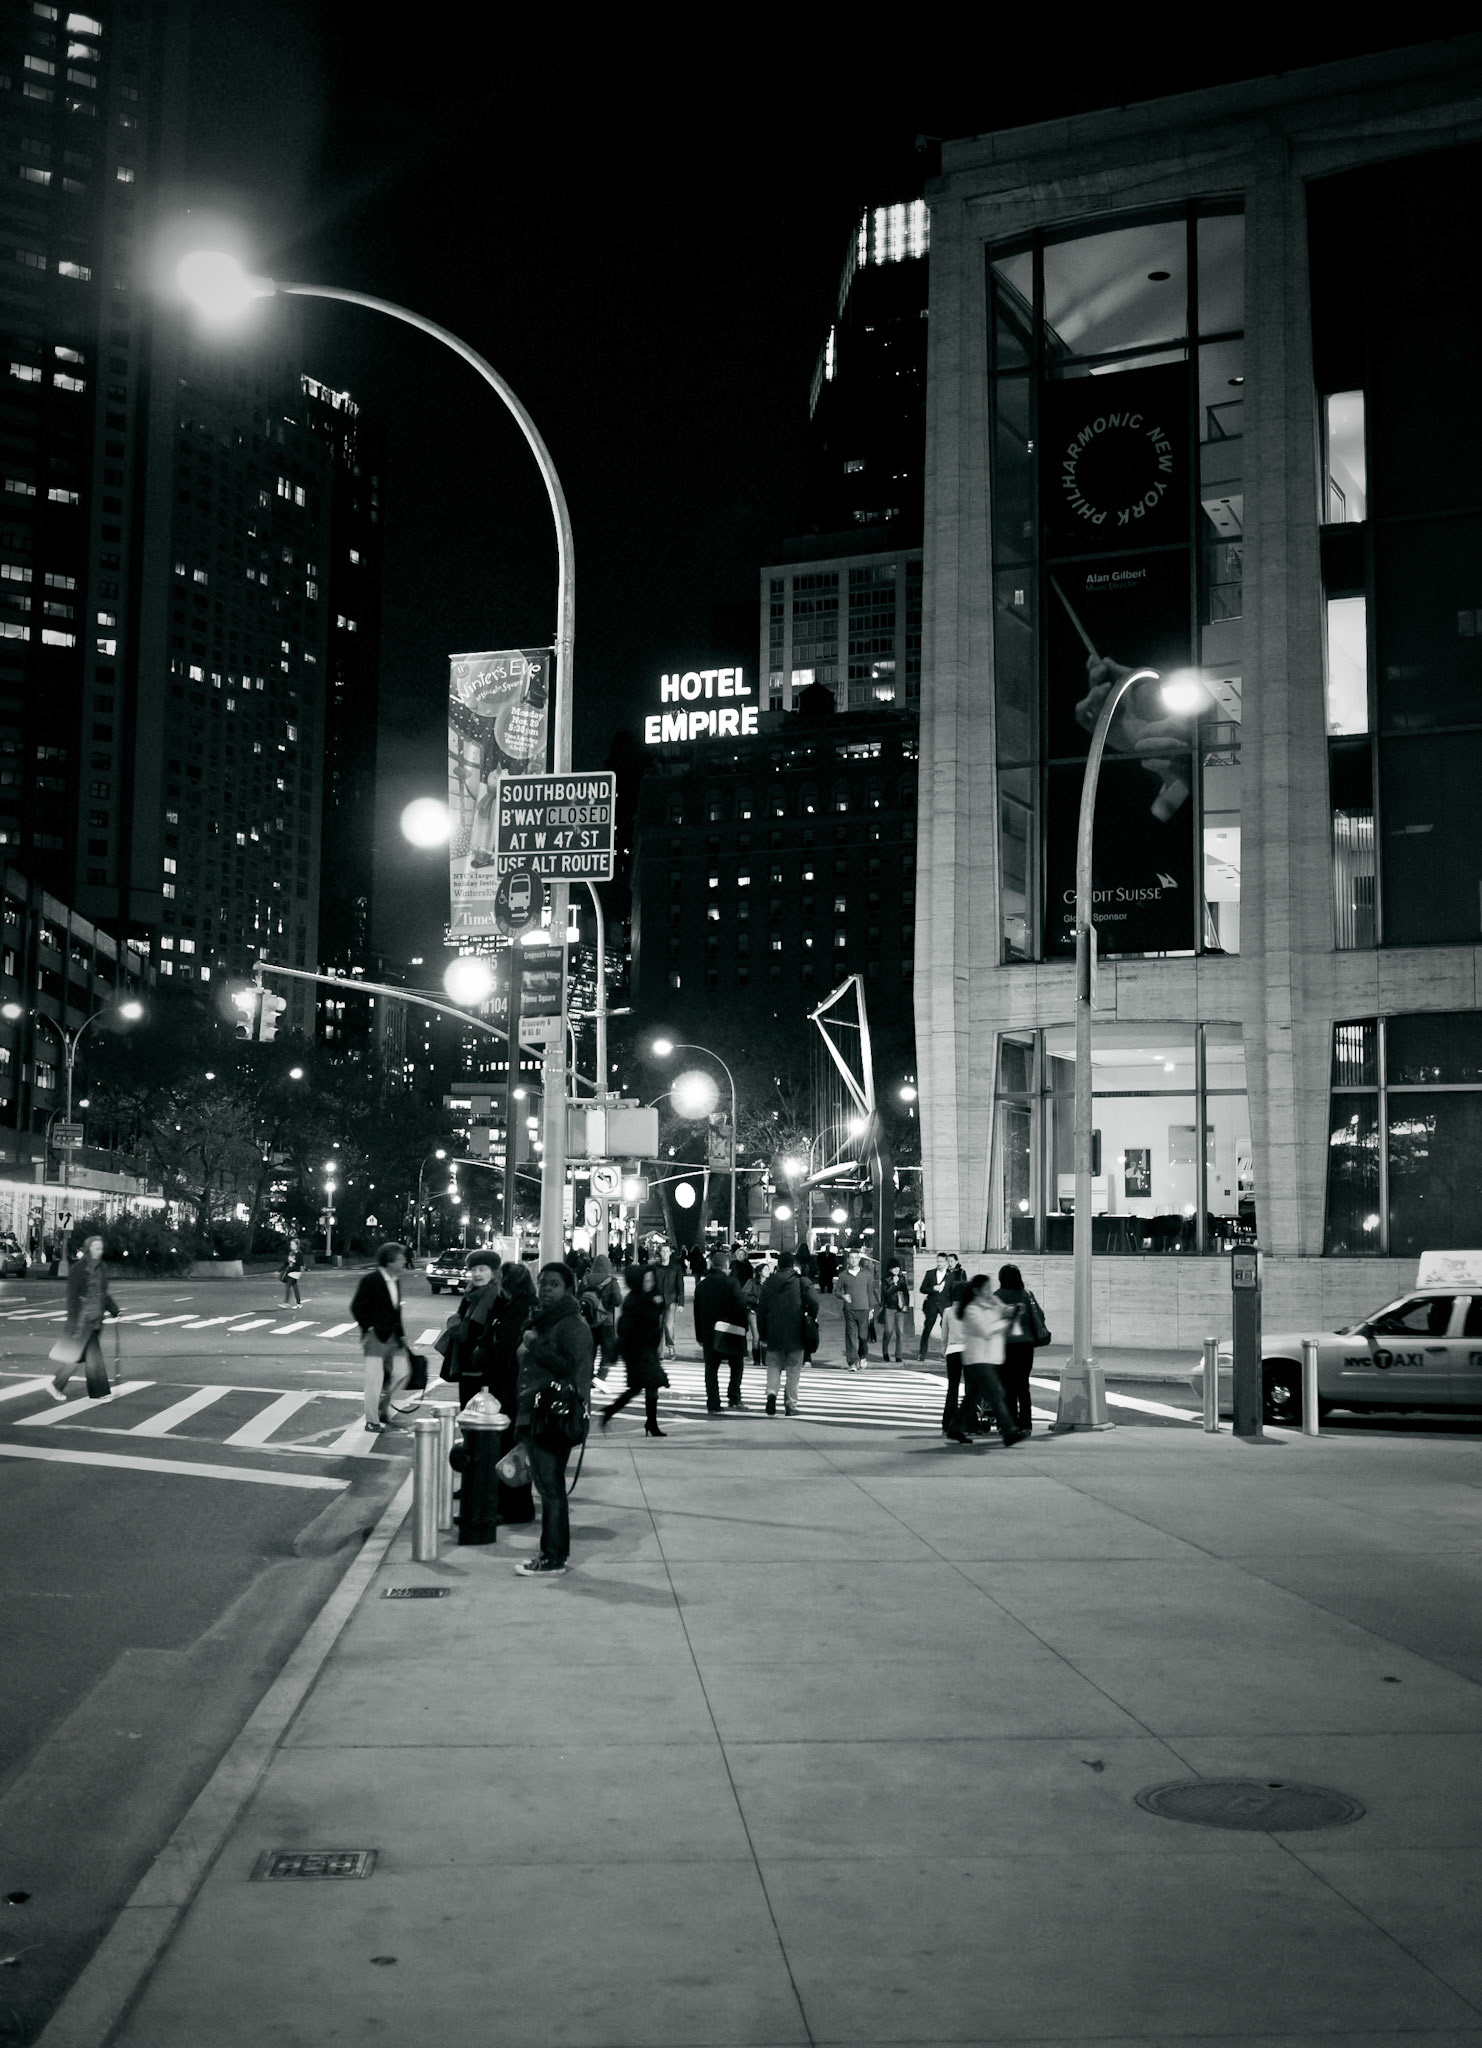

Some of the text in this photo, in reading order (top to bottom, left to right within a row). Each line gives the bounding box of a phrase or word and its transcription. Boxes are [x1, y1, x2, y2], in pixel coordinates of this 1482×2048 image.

[1061, 411, 1173, 526] NEW YORK PHILHARMONIC
[1086, 568, 1147, 583] Alan Gilbert
[661, 667, 752, 703] HOTEL
[511, 706, 544, 721] Monday
[645, 705, 759, 744] EMPIRE
[502, 782, 610, 803] SOUTHBOUND
[501, 806, 609, 827] B'WAY CLOSED
[509, 830, 600, 850] AT W 47 ST
[531, 855, 557, 873] ALT
[561, 854, 609, 872] ROUTE
[1063, 886, 1162, 905] CDIT SUISSE
[1093, 912, 1128, 922] Sponsor
[480, 996, 508, 1014] M104
[1344, 1348, 1425, 1370] NYC TAXI
